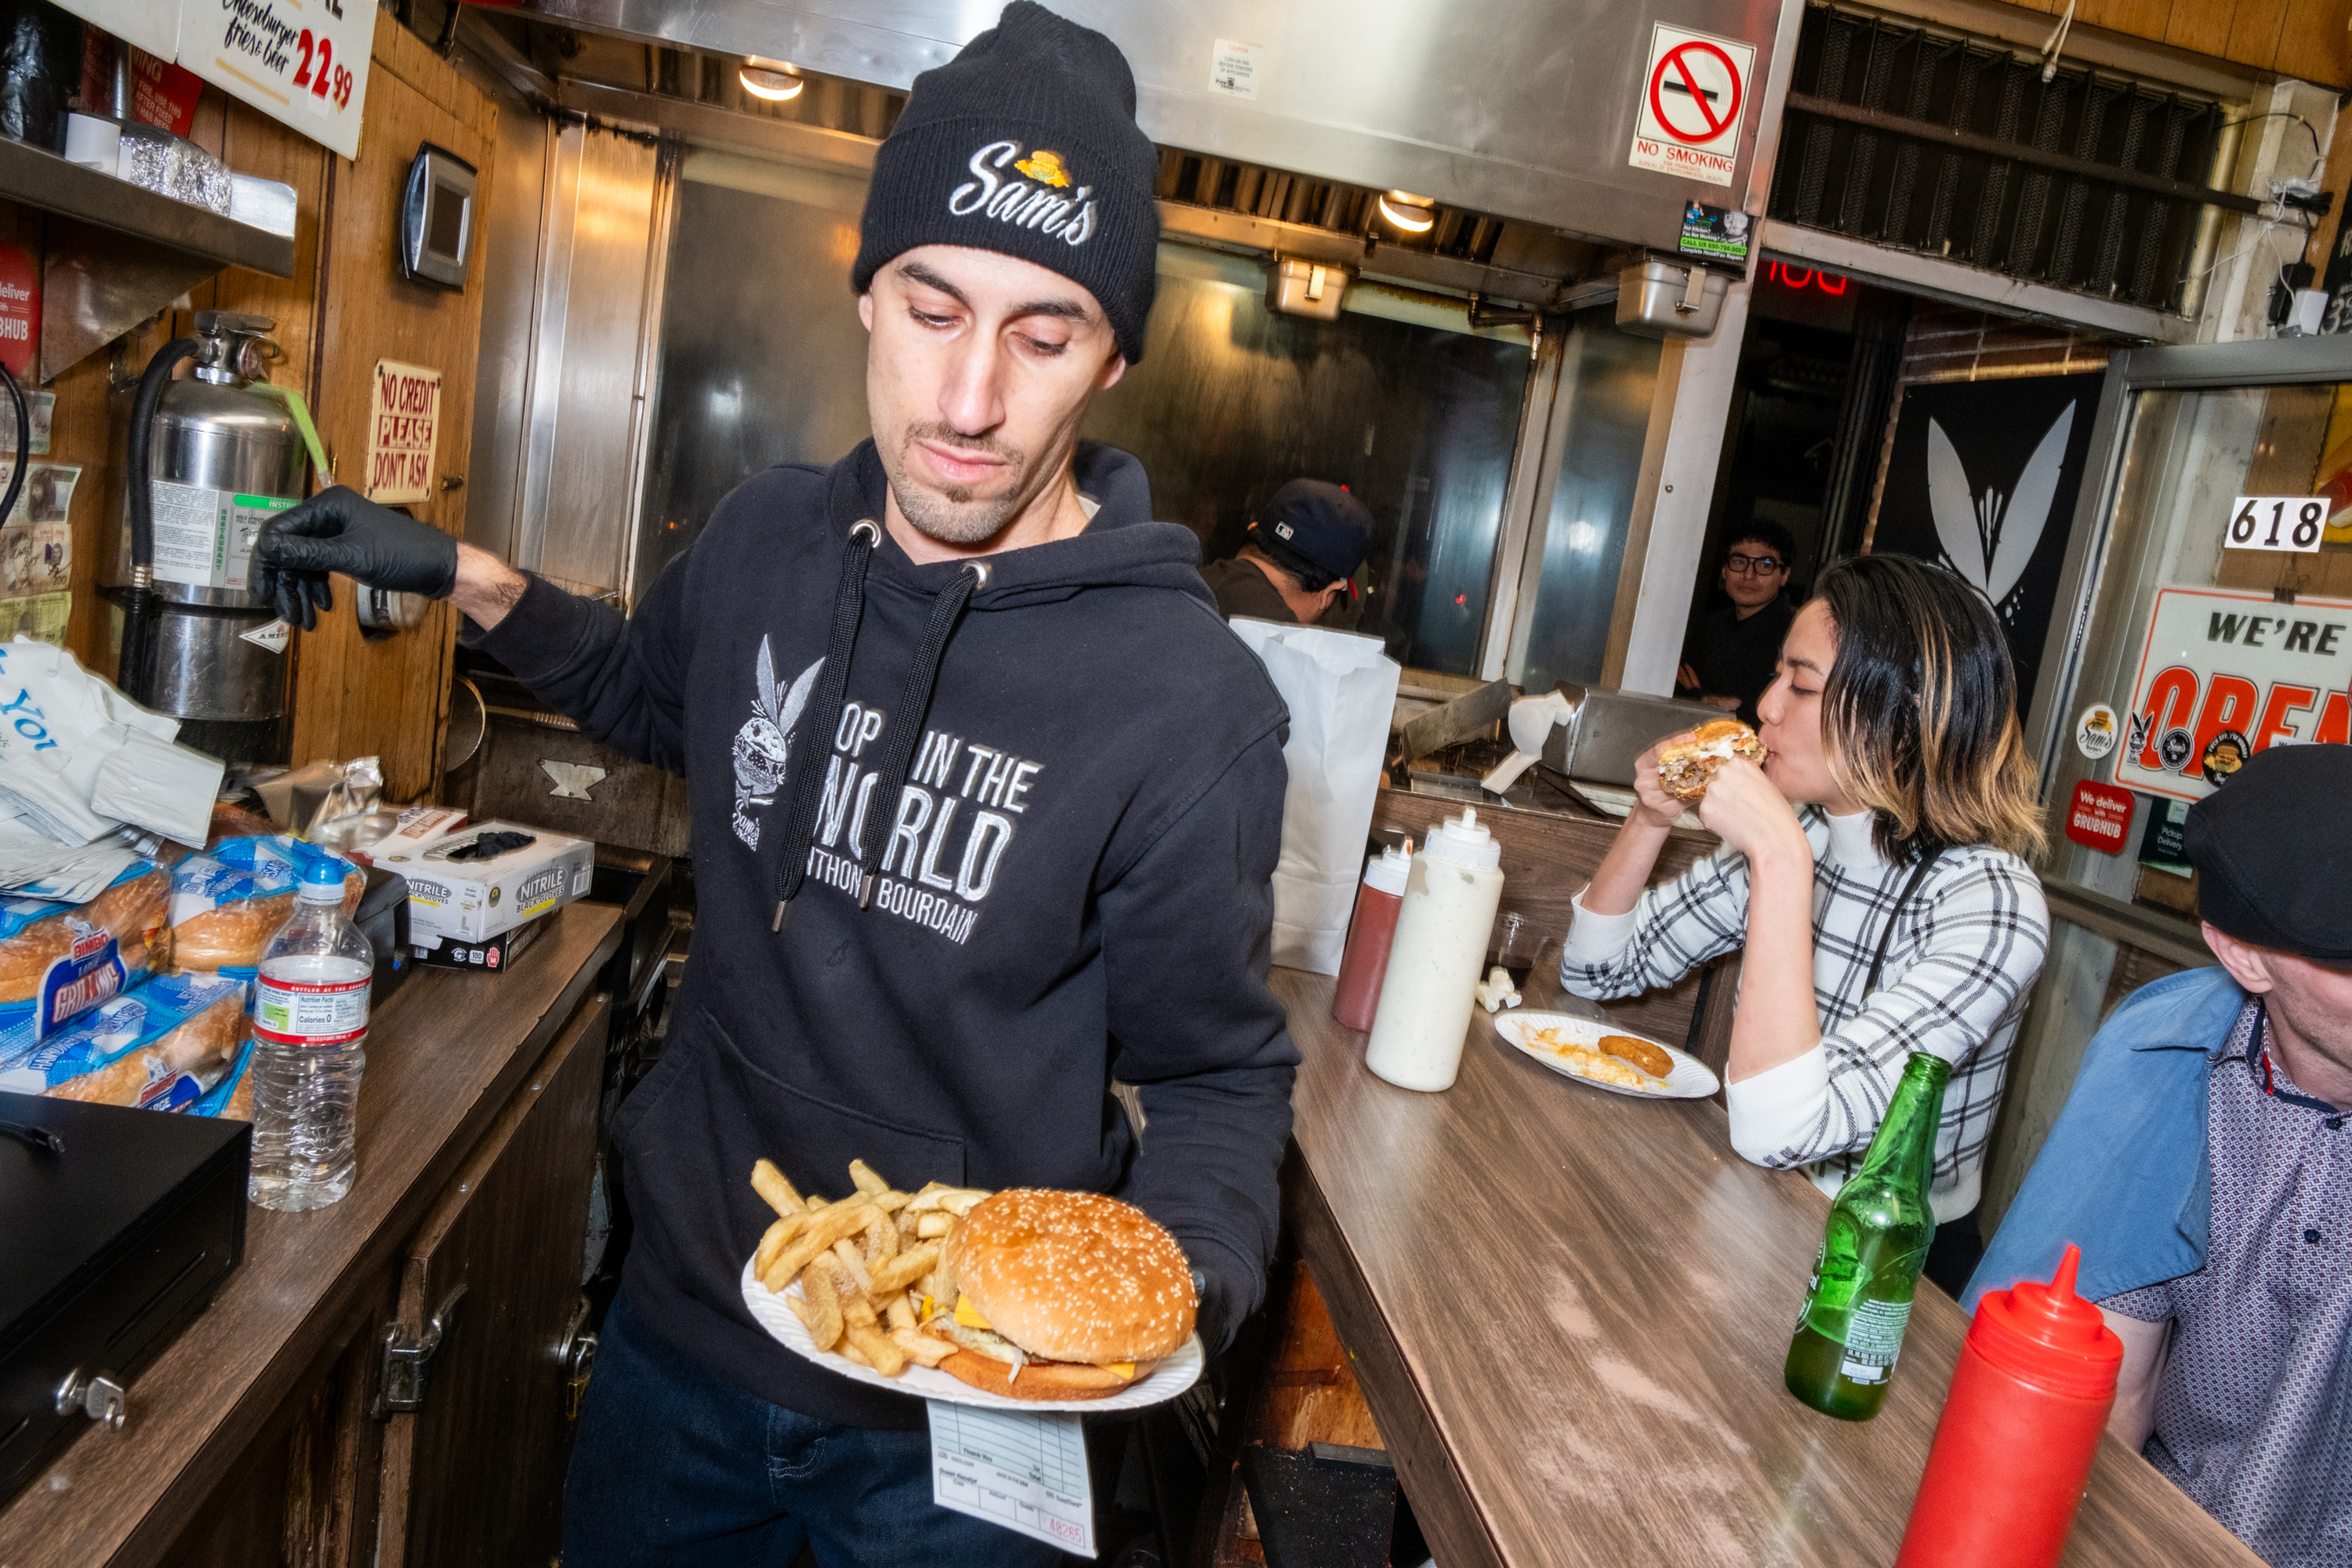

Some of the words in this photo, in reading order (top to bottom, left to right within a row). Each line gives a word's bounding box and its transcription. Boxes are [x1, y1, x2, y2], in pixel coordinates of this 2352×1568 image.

[263, 38, 289, 75] beer
[1228, 45, 1249, 53] CAUTION
[1226, 69, 1250, 78] APPLIANCES
[1234, 64, 1254, 73] STARTING
[140, 107, 154, 122] HAS
[154, 93, 169, 109] USE
[168, 103, 183, 119] THIS
[156, 105, 173, 124] FIXED
[1638, 140, 1659, 156] NO
[1666, 147, 1733, 173] SMOKING
[1639, 160, 1657, 169] BUREAU
[1667, 167, 1704, 179] ENVIRONMENTAL
[1674, 162, 1700, 172] FRANCISCO
[949, 140, 1092, 246] Sam's
[1680, 246, 1703, 255] Complete
[0, 281, 30, 301] eliver
[0, 302, 9, 311] ith
[380, 372, 397, 412] NO
[399, 376, 436, 416] CREDIT
[379, 416, 431, 449] PLEASE
[372, 452, 407, 491] DON'T
[407, 454, 429, 490] ASK
[2231, 499, 2322, 549] 618
[53, 575, 67, 586] 200
[2207, 612, 2347, 657] WE'RE
[2078, 725, 2113, 750] Sam's
[835, 703, 881, 757] OP
[911, 730, 960, 789] IN
[959, 745, 1040, 814] THE
[2080, 789, 2095, 805] We
[2096, 795, 2127, 814] deliver
[2172, 805, 2185, 814] Uber
[2094, 808, 2107, 817] with
[2073, 812, 2122, 839] GRUBHUB
[2161, 827, 2183, 840] Pickup.
[2157, 836, 2183, 851] Delivery.
[406, 880, 448, 898] NITRILE
[520, 869, 564, 902] NITRILE
[423, 894, 449, 905] GLOVES
[516, 898, 538, 913] BLACK
[539, 885, 565, 903] GLOVES
[876, 877, 979, 946] BOURDAIN
[74, 933, 109, 960] BIMBO
[299, 1015, 325, 1024] Calories
[326, 1014, 332, 1023] 0
[140, 1073, 177, 1105] BIMBO
[963, 1447, 981, 1459] Thank
[981, 1452, 993, 1463] You
[938, 1467, 956, 1478] Guest
[956, 1472, 978, 1486] Receipt
[1019, 1479, 1029, 1488] USA
[1028, 1472, 1042, 1483] Total
